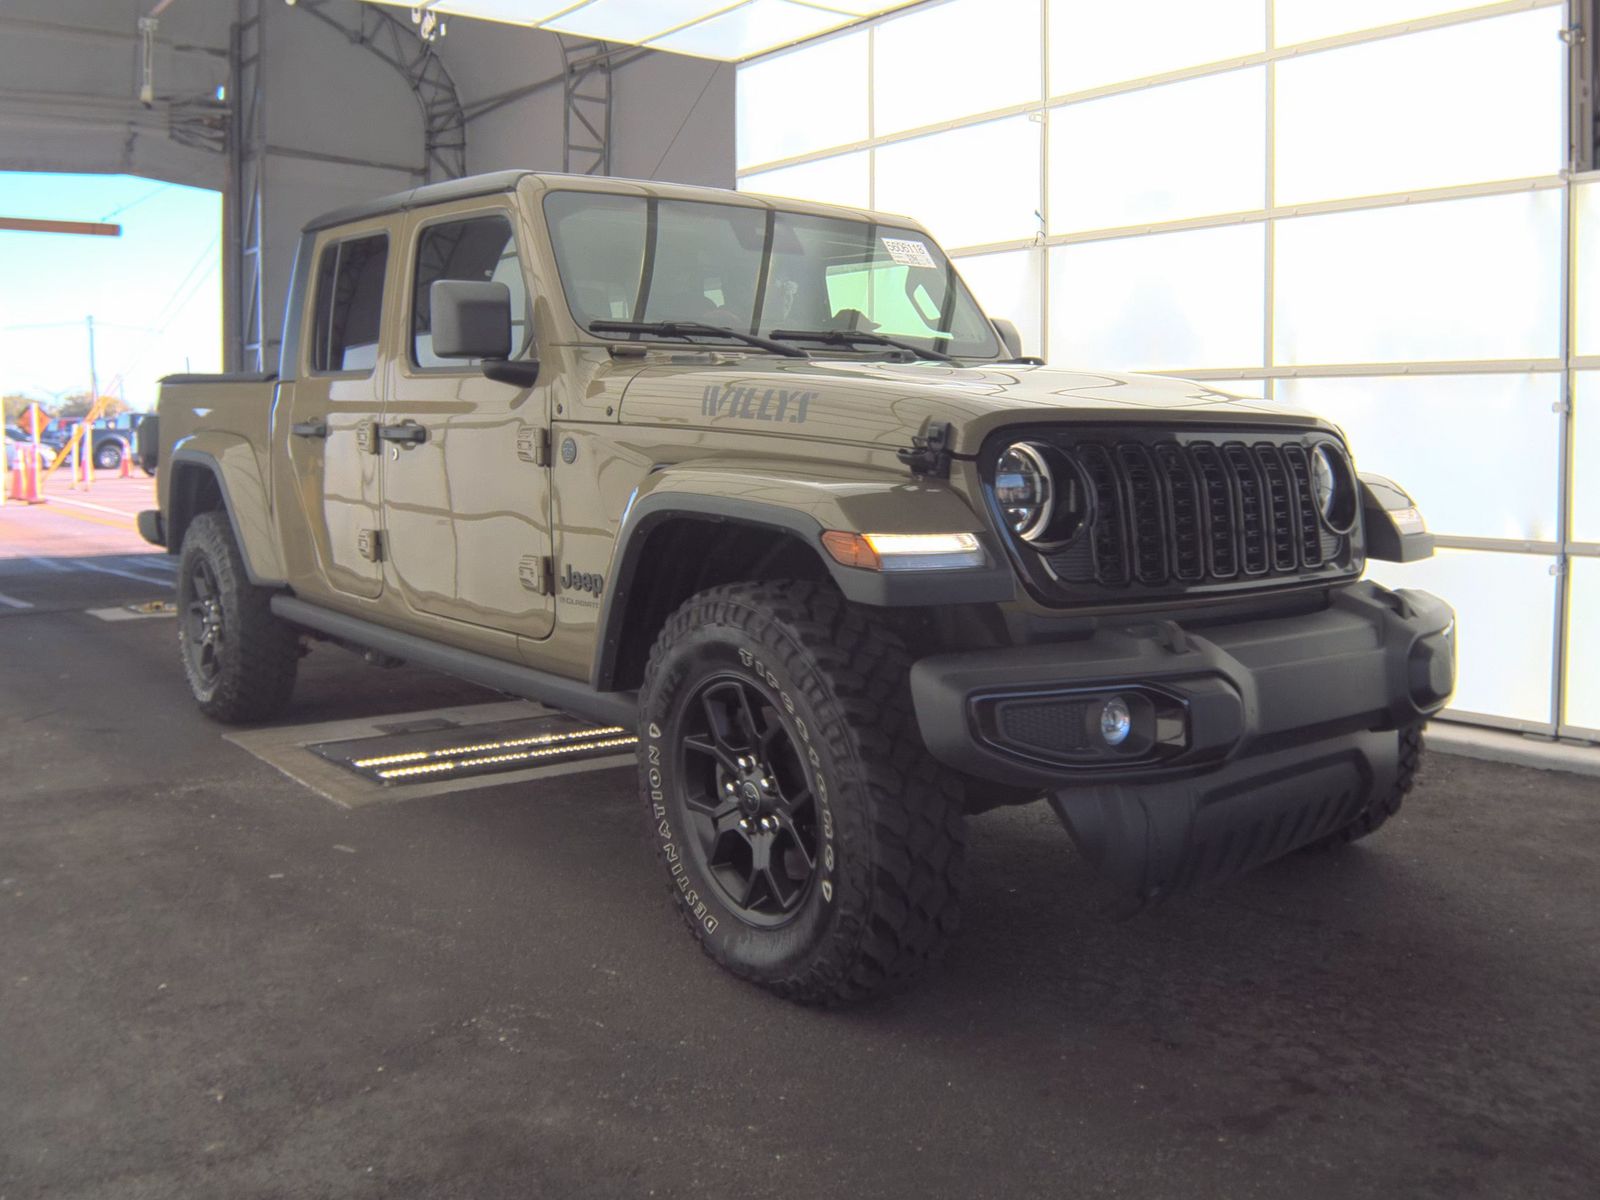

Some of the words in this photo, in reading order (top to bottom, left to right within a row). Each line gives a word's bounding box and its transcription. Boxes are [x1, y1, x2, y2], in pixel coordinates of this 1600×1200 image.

[702, 385, 819, 423] WILLYS
[560, 564, 604, 599] Jeep
[649, 745, 719, 934] DESTINATION
